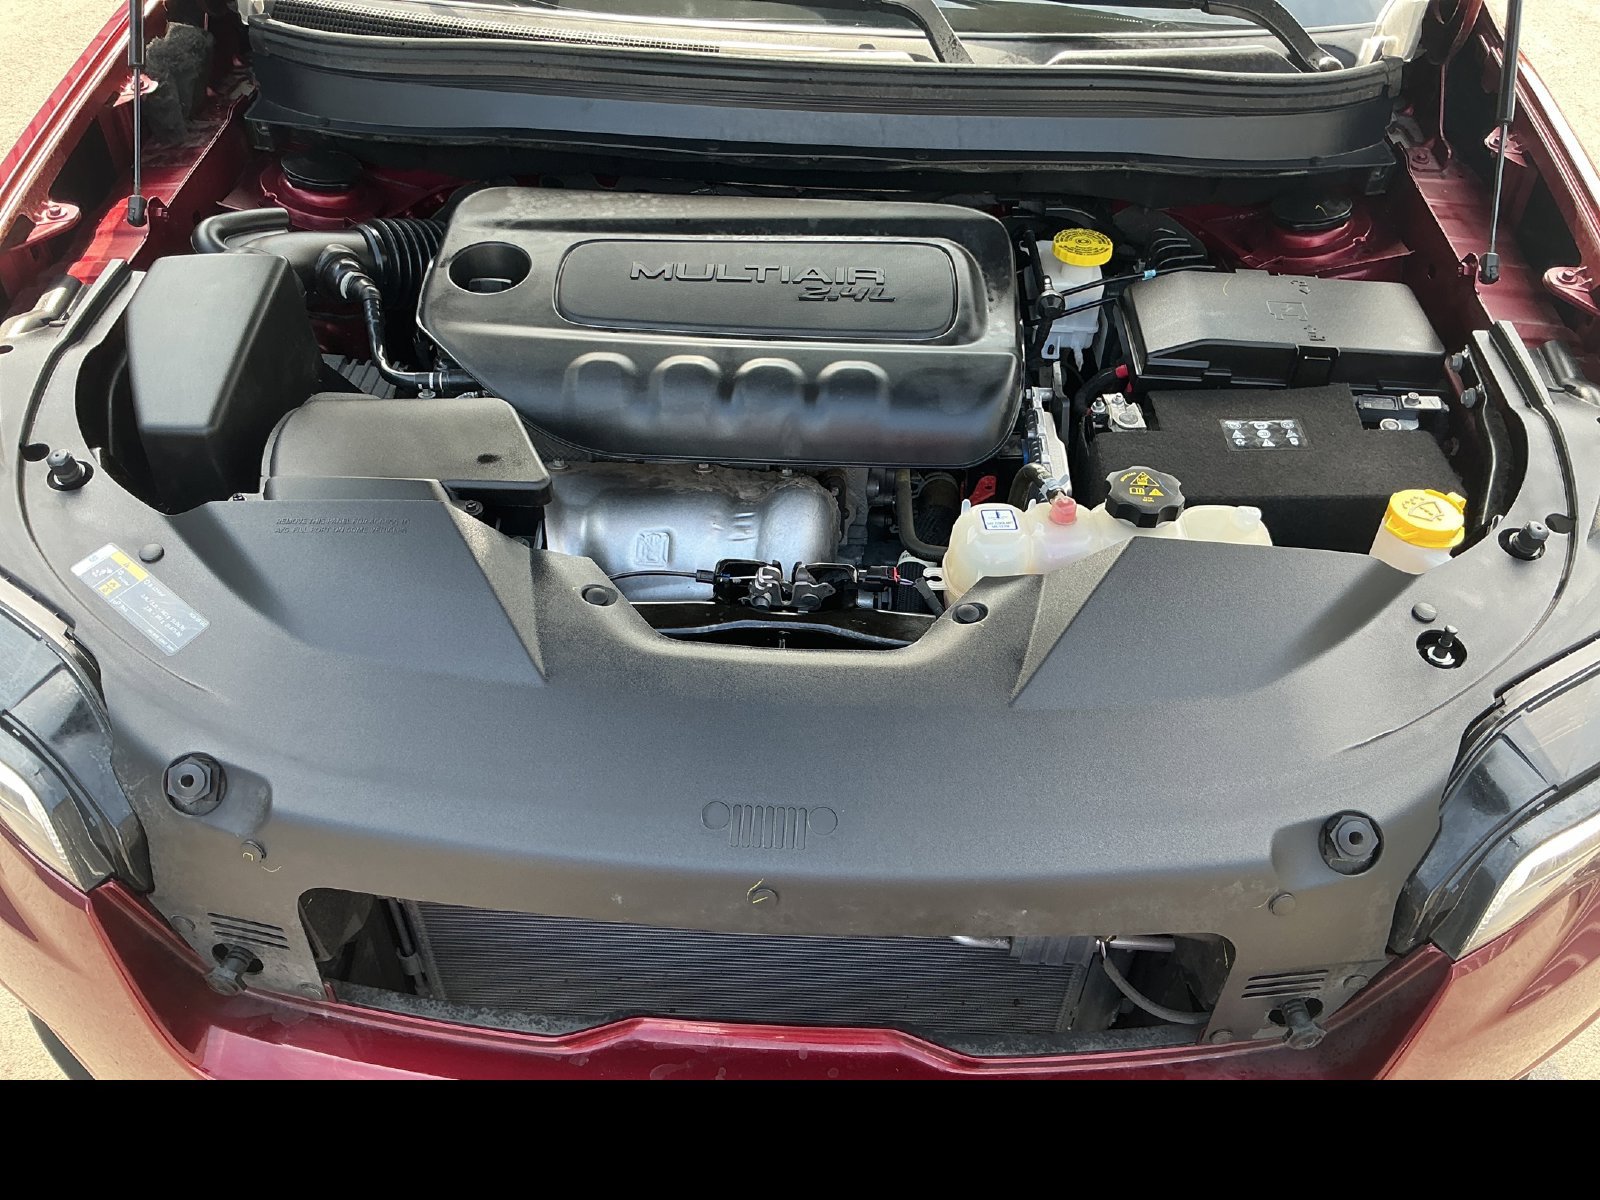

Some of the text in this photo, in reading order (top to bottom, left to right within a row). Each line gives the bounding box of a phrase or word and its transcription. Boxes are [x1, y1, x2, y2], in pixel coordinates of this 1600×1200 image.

[630, 261, 885, 284] MULTIAIR
[798, 286, 895, 302] 2.4L
[310, 526, 331, 534] PORT
